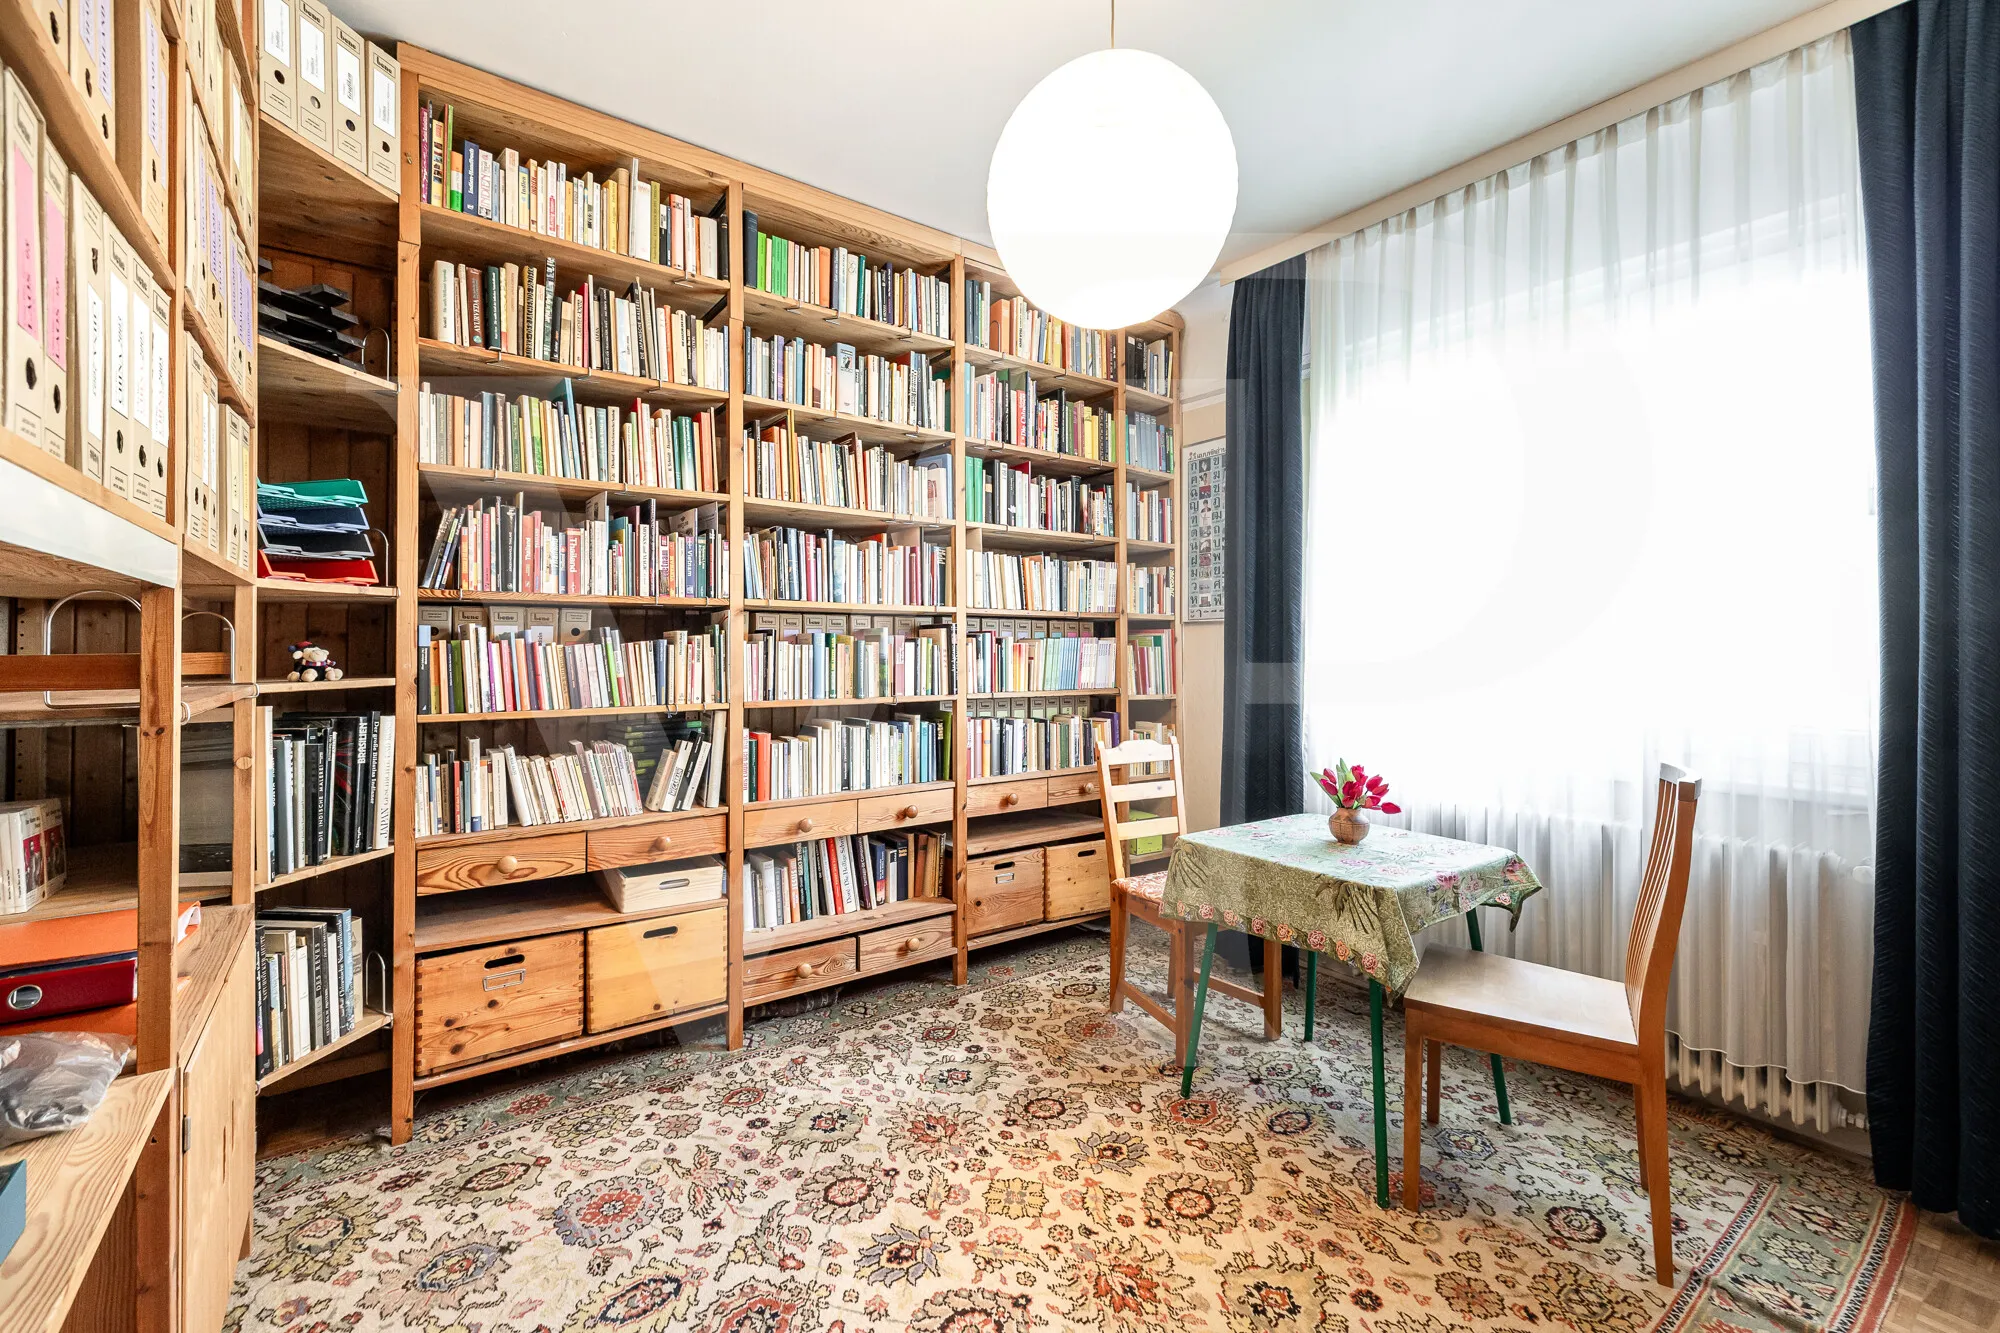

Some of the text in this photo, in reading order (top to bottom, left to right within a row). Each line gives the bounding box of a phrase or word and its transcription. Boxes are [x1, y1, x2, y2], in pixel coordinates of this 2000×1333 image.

[303, 4, 321, 24] bene
[340, 30, 357, 50] bene
[376, 56, 393, 75] bene
[481, 175, 491, 208] INDIEN
[462, 611, 480, 620] bene
[497, 612, 515, 622] bene
[357, 722, 367, 764] BRASILIEN
[380, 808, 389, 838] JAPAN
